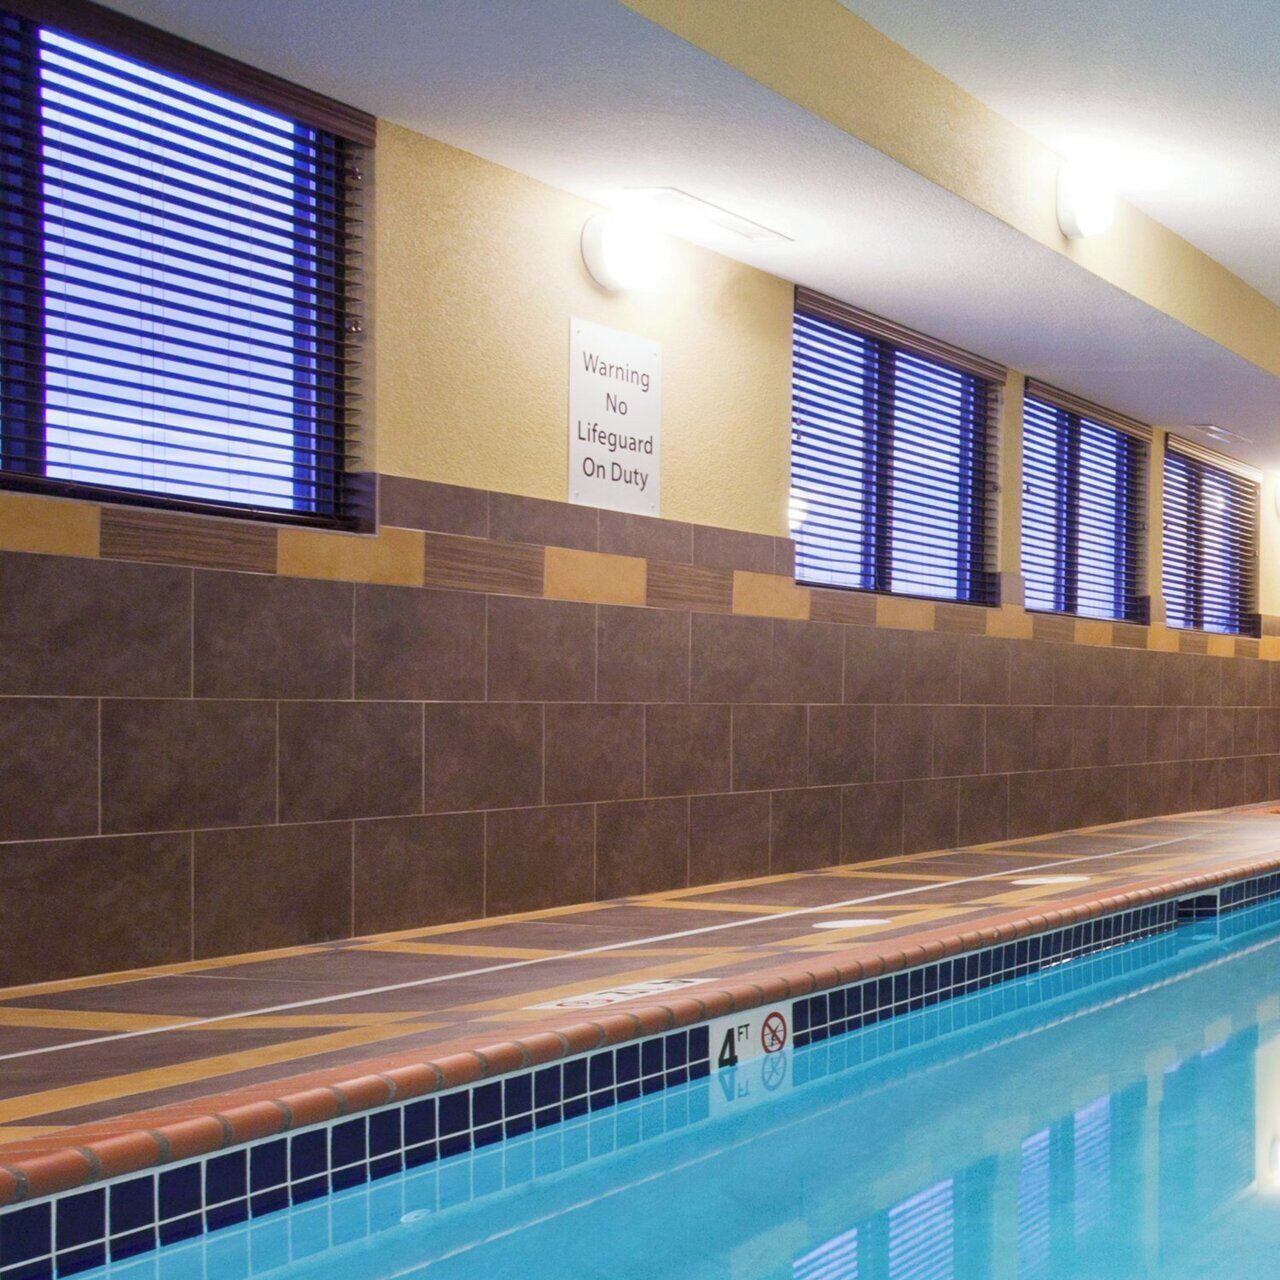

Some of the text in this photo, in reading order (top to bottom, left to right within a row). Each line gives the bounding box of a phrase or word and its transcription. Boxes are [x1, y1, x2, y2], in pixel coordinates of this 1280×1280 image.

[583, 351, 650, 393] Warning
[606, 392, 628, 416] No
[577, 420, 653, 455] Lifeguard
[582, 457, 649, 492] On Duty
[718, 1024, 750, 1068] 4 FT
